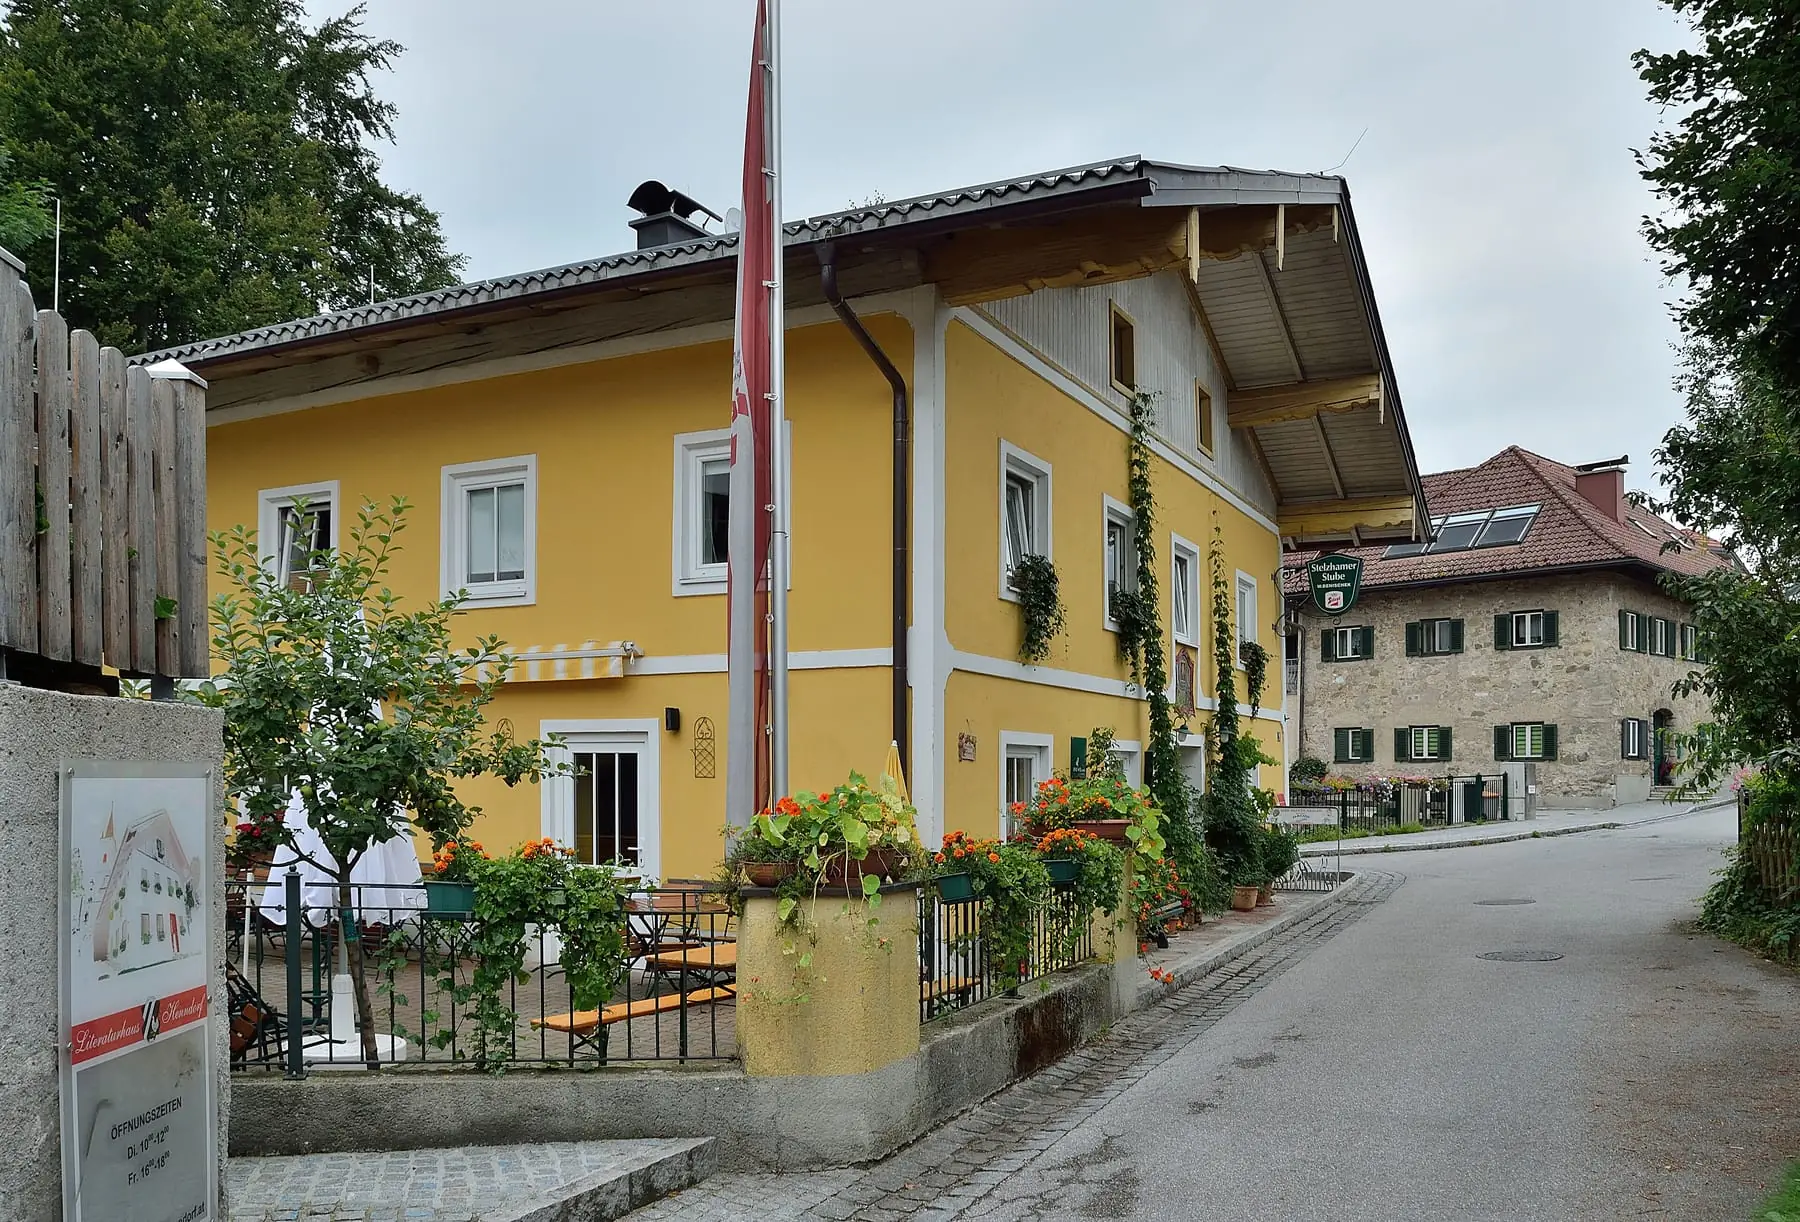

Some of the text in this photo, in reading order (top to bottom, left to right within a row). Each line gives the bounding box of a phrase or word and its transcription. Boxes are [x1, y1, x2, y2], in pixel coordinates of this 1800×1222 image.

[1311, 562, 1357, 572] Stelzhamer
[1322, 572, 1345, 581] Stube
[75, 993, 206, 1054] Literaturhaus Henndorf
[111, 1096, 182, 1140] ÖFFNUNGSZEITEN
[127, 1144, 138, 1160] Di.
[128, 1172, 139, 1186] Fr.
